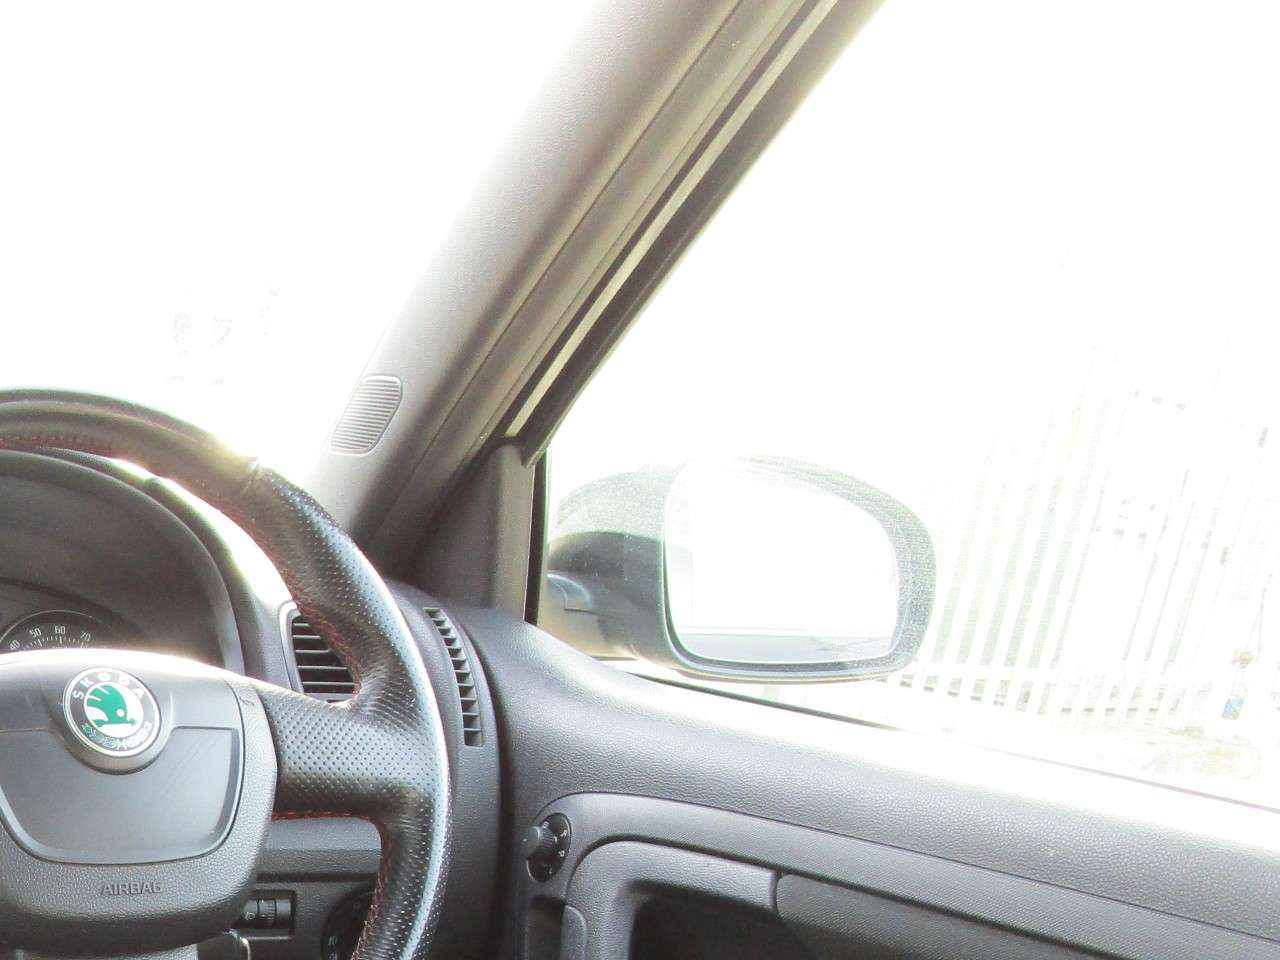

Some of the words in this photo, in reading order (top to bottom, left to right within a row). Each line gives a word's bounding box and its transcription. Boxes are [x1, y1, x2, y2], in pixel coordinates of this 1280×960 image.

[29, 627, 42, 639] 50
[54, 625, 66, 635] 60
[80, 631, 92, 642] 70
[9, 639, 20, 651] 40
[101, 881, 161, 896] AIRBAG
